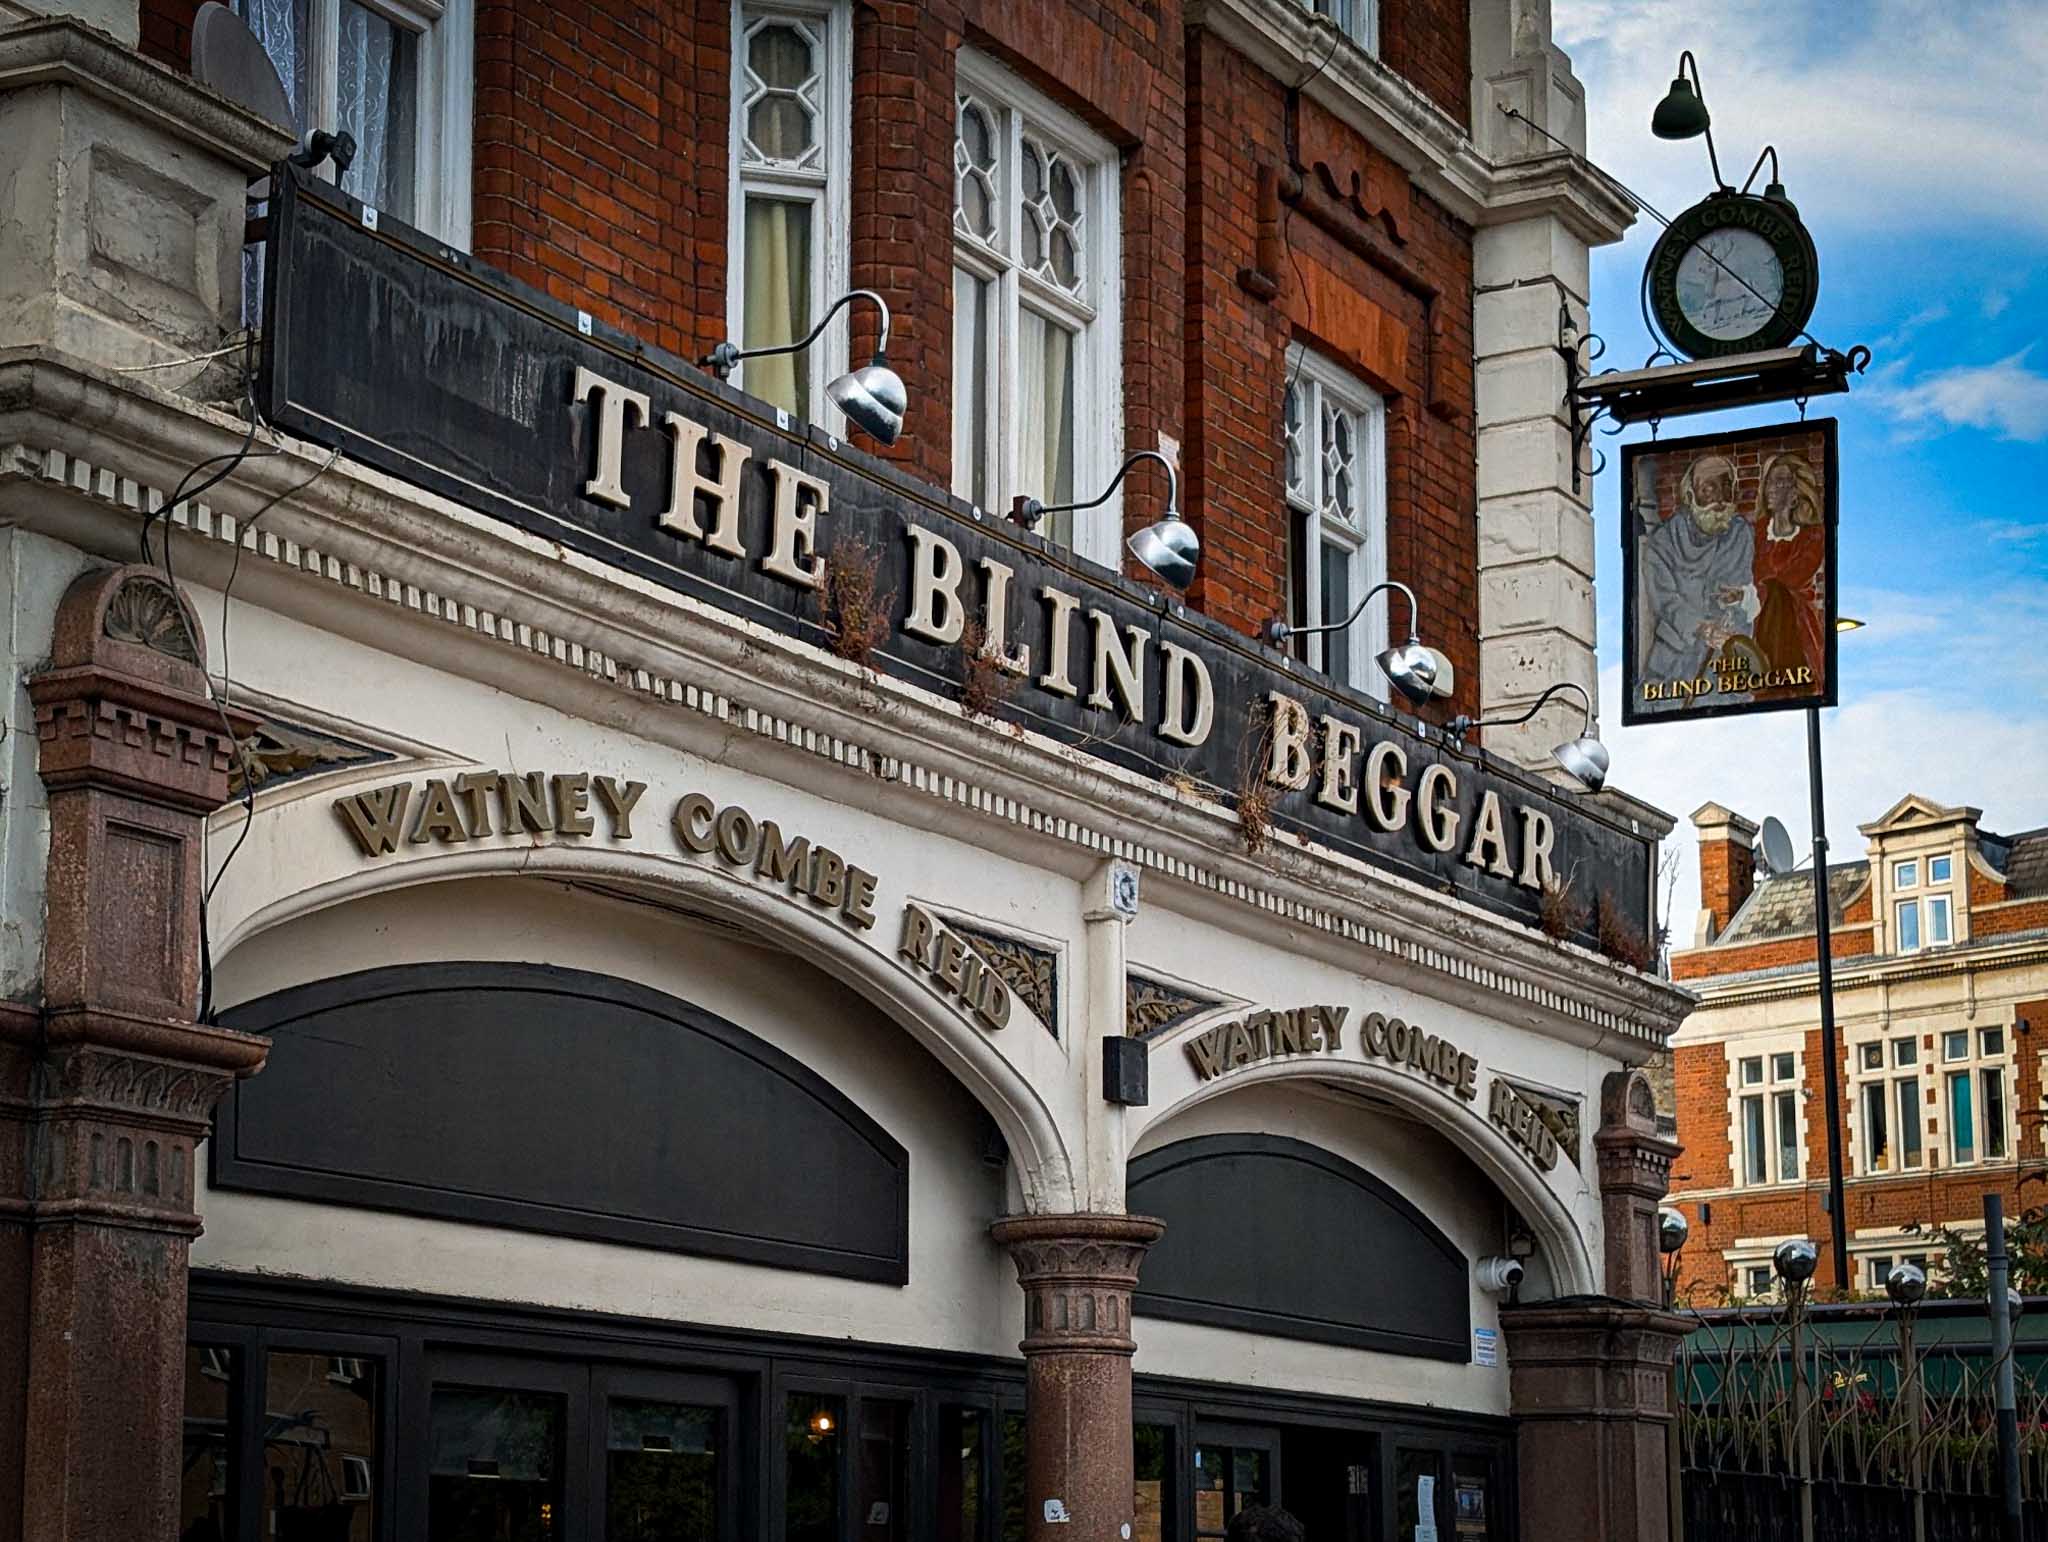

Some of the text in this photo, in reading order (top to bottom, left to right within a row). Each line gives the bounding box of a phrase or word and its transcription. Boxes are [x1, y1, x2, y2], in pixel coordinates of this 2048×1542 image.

[1656, 206, 1804, 335] WATNEY COMBE REID
[574, 366, 1561, 893] THE BLIND BEGGAR
[1643, 666, 1814, 701] BLIND BEGGAR
[1708, 656, 1750, 674] THE
[334, 769, 1011, 1030] WATNEY COMBE REID
[1184, 1004, 1558, 1172] WATNEY COMBE REID
